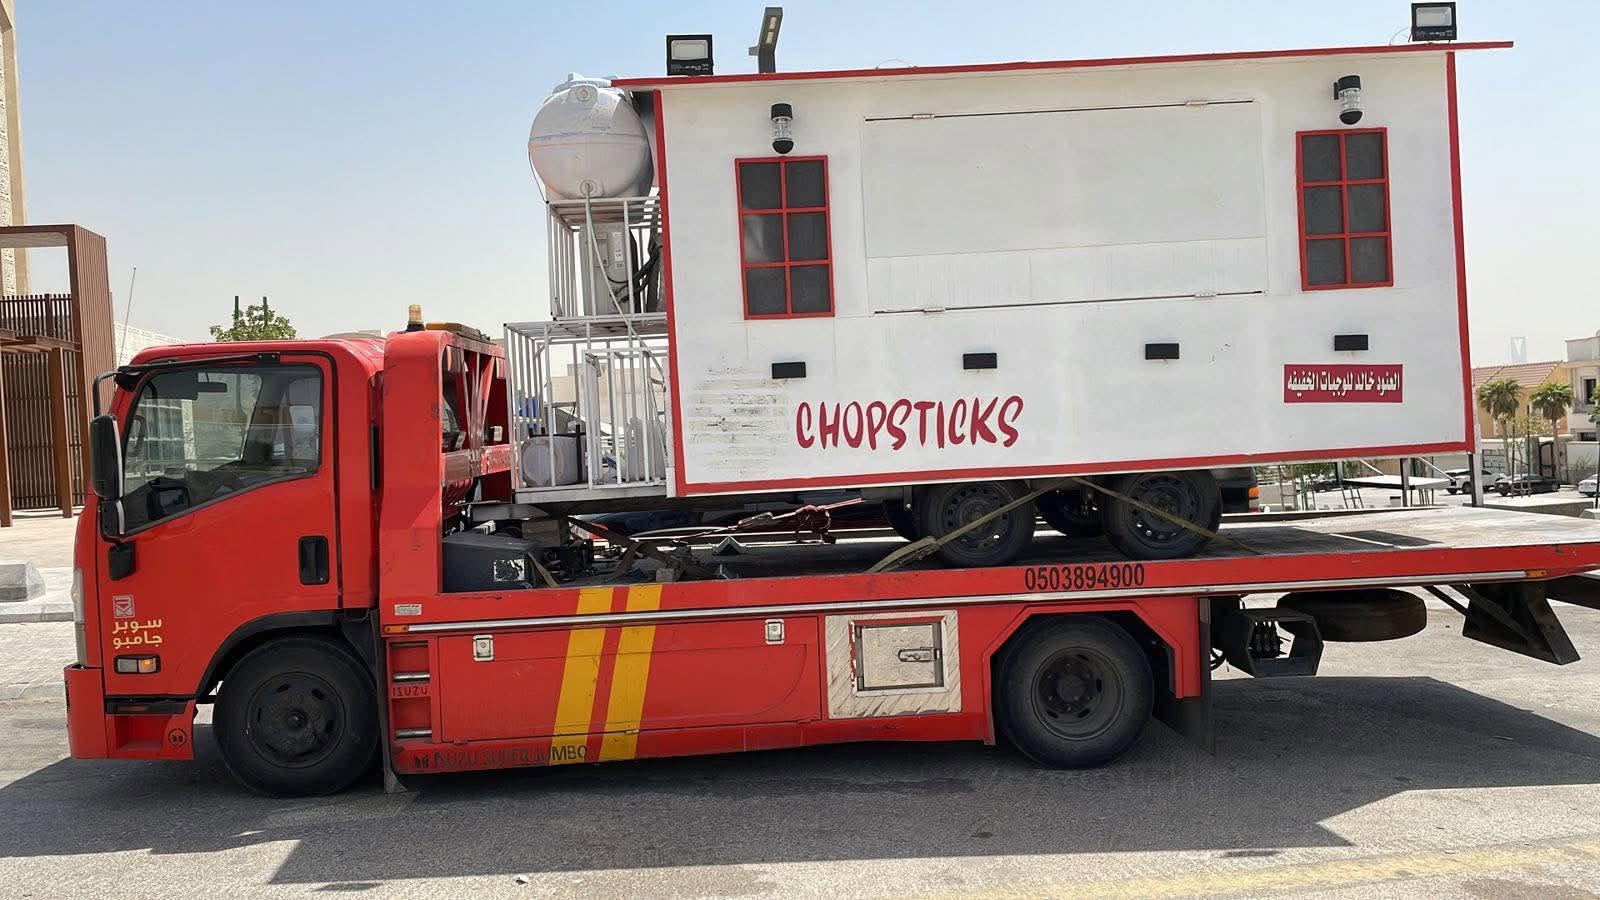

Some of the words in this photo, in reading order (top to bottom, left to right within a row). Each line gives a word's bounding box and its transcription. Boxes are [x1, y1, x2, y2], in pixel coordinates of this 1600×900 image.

[1320, 370, 1354, 396] للوجبات
[1354, 370, 1375, 391] خالد
[1377, 371, 1400, 396] العنود
[796, 395, 1024, 451] CHOPSTICKS
[1024, 563, 1145, 590] 0503894900
[112, 618, 162, 634] سوبر
[112, 630, 163, 650] جامبو
